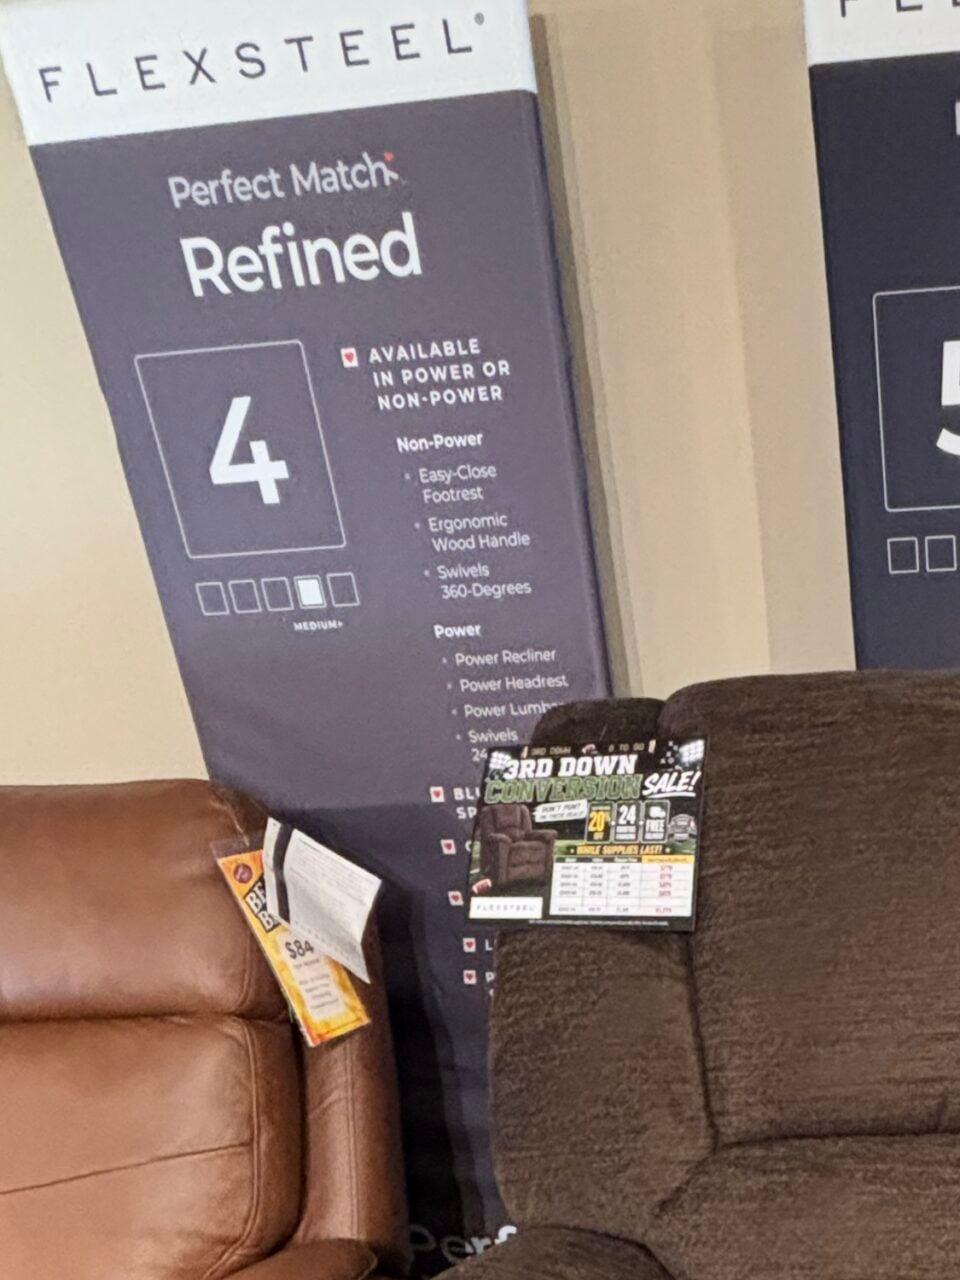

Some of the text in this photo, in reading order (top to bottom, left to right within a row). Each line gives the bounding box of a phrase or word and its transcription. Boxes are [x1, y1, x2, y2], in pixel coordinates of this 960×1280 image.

[167, 151, 399, 210] Perfect Match
[180, 211, 423, 298] Refined
[368, 338, 481, 364] AVAILABLE
[372, 360, 511, 388] IN POWER OR
[377, 385, 504, 411] NON-POWER
[209, 394, 290, 505] 4
[396, 433, 484, 452] Non-Power
[418, 464, 498, 484] Easy-Close
[422, 486, 484, 504] Footrest
[428, 512, 509, 534] Ergonomic
[431, 531, 531, 552] Wood Handle
[437, 562, 491, 580] Swivels
[440, 581, 533, 600] 360-Degrees
[433, 623, 482, 639] Power
[454, 649, 557, 667] Power Recliner
[459, 674, 569, 693] Power Headrest
[463, 704, 506, 718] Power
[467, 728, 519, 744] Swivels
[503, 754, 638, 780] 3RD DOWN
[484, 774, 643, 804] CONVERSION
[641, 770, 702, 796] SALE!
[618, 804, 637, 825] 24
[645, 819, 665, 833] FREE
